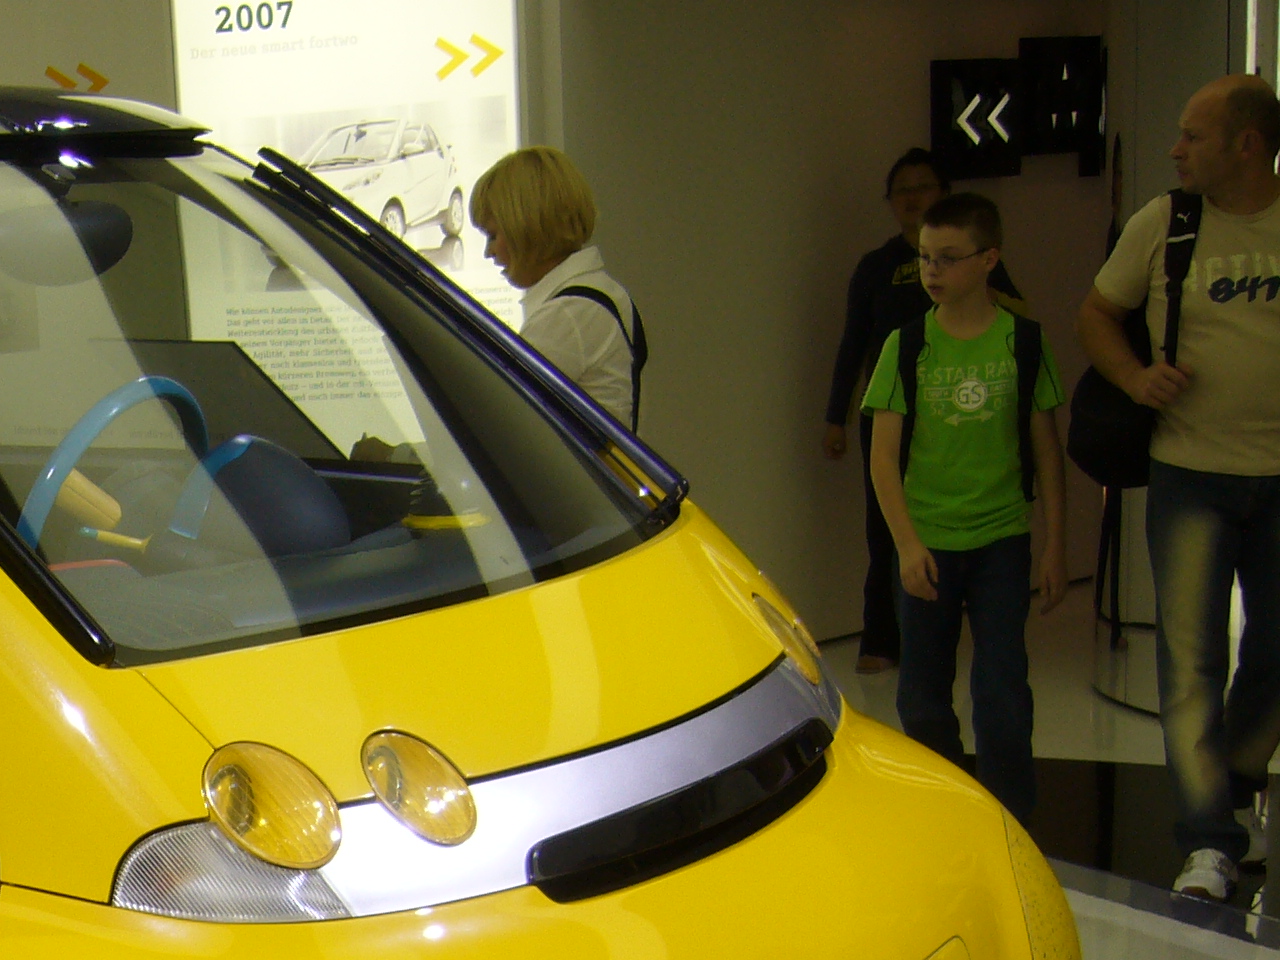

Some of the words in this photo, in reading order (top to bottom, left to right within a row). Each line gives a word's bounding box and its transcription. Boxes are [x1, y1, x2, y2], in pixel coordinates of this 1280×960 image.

[214, 0, 294, 34] 2007
[190, 47, 215, 60] Der
[221, 43, 257, 57] neue
[261, 39, 305, 54] smart
[308, 34, 359, 50] fortwo
[957, 386, 983, 404] GS
